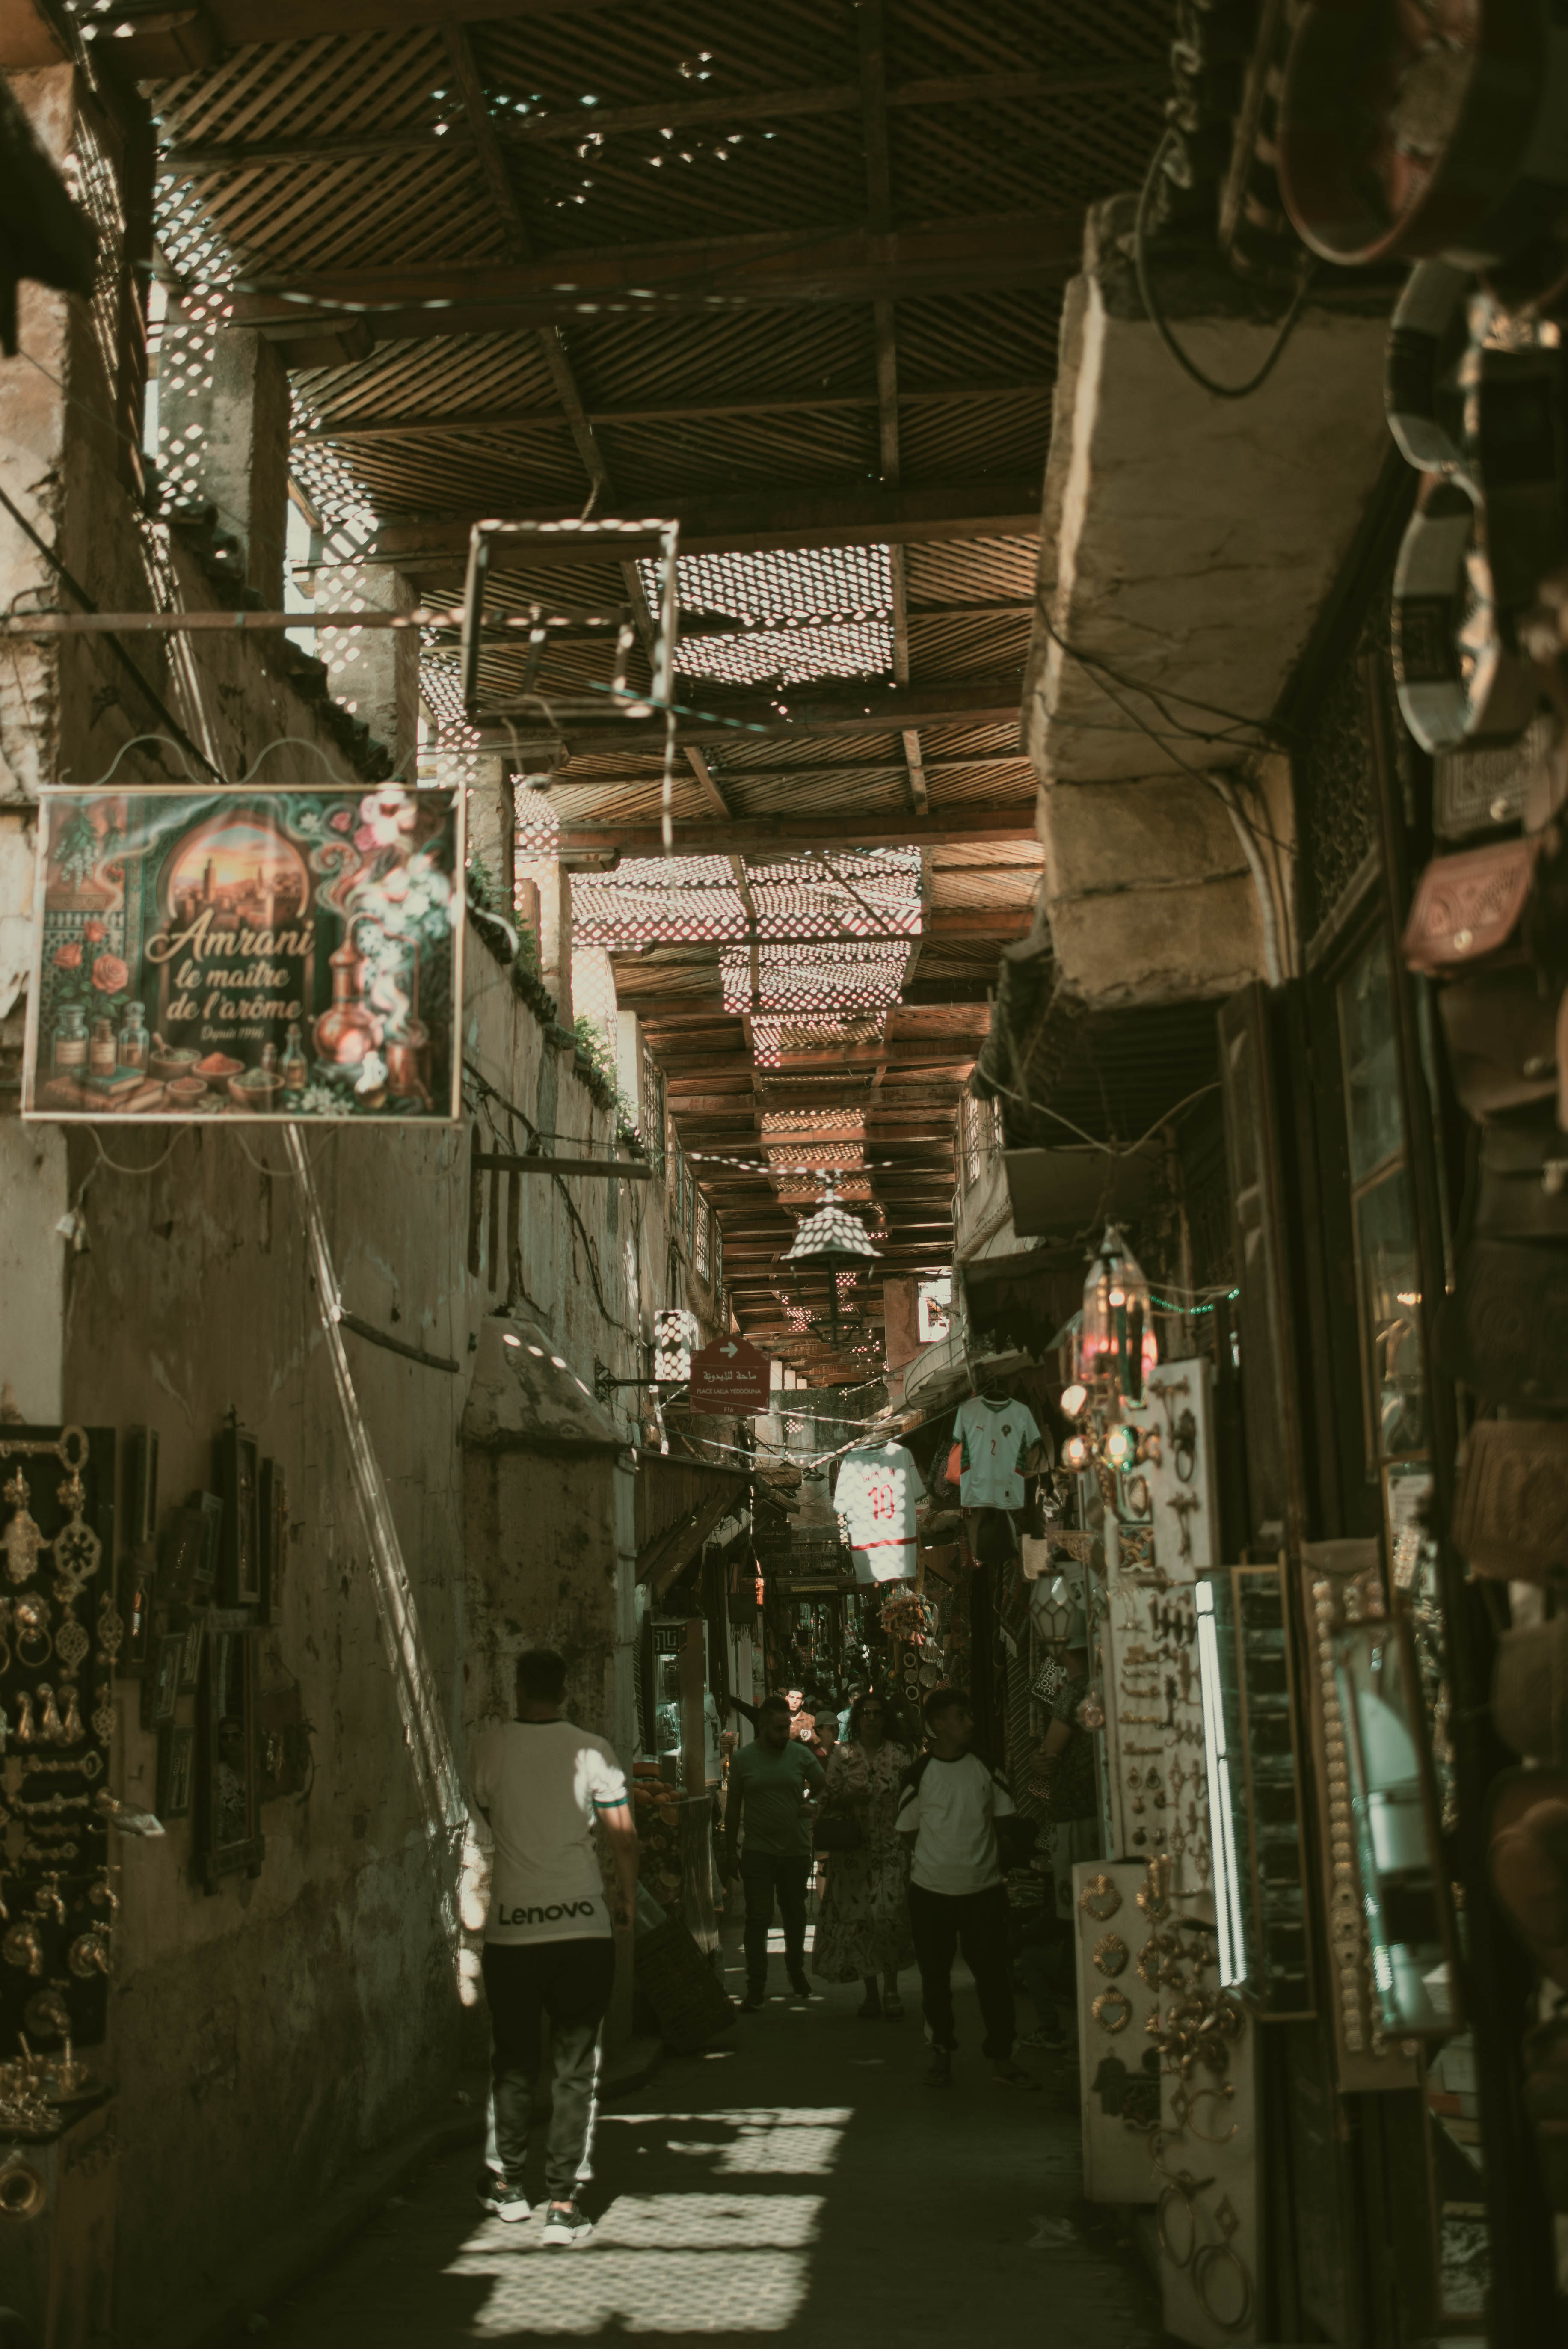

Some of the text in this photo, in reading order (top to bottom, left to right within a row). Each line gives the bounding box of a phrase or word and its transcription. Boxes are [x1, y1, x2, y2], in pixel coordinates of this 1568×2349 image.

[145, 908, 316, 963] Amrani
[175, 958, 290, 988] le maître
[166, 991, 200, 1020] de
[736, 1370, 756, 1379] ساحة
[991, 1439, 996, 1456] 2
[868, 1484, 895, 1520] 10
[499, 1901, 594, 1925] Lenovo
